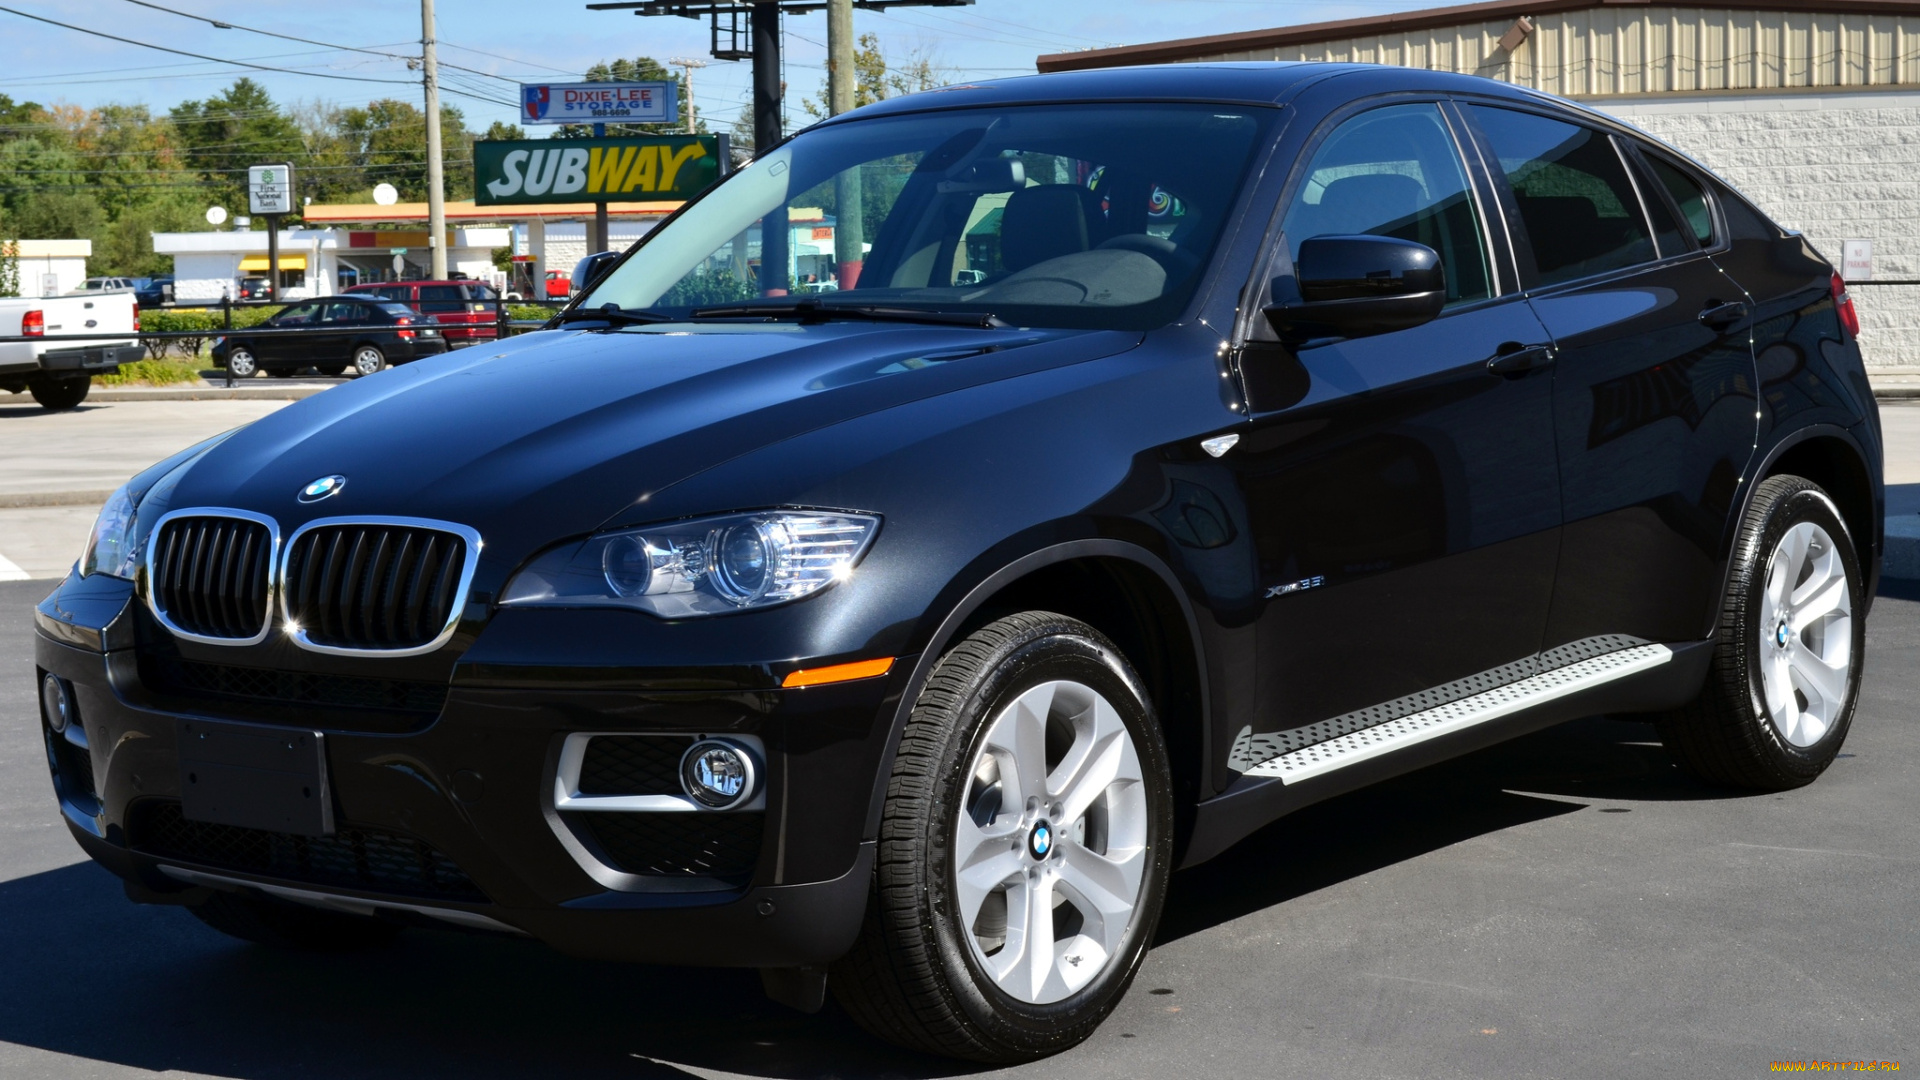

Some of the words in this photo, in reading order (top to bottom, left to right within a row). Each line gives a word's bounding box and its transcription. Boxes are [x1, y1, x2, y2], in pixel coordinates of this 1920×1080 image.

[564, 90, 612, 102] DIXIE
[616, 88, 652, 101] LEE
[564, 100, 653, 111] STORAGE
[486, 139, 708, 200] SUBWAY
